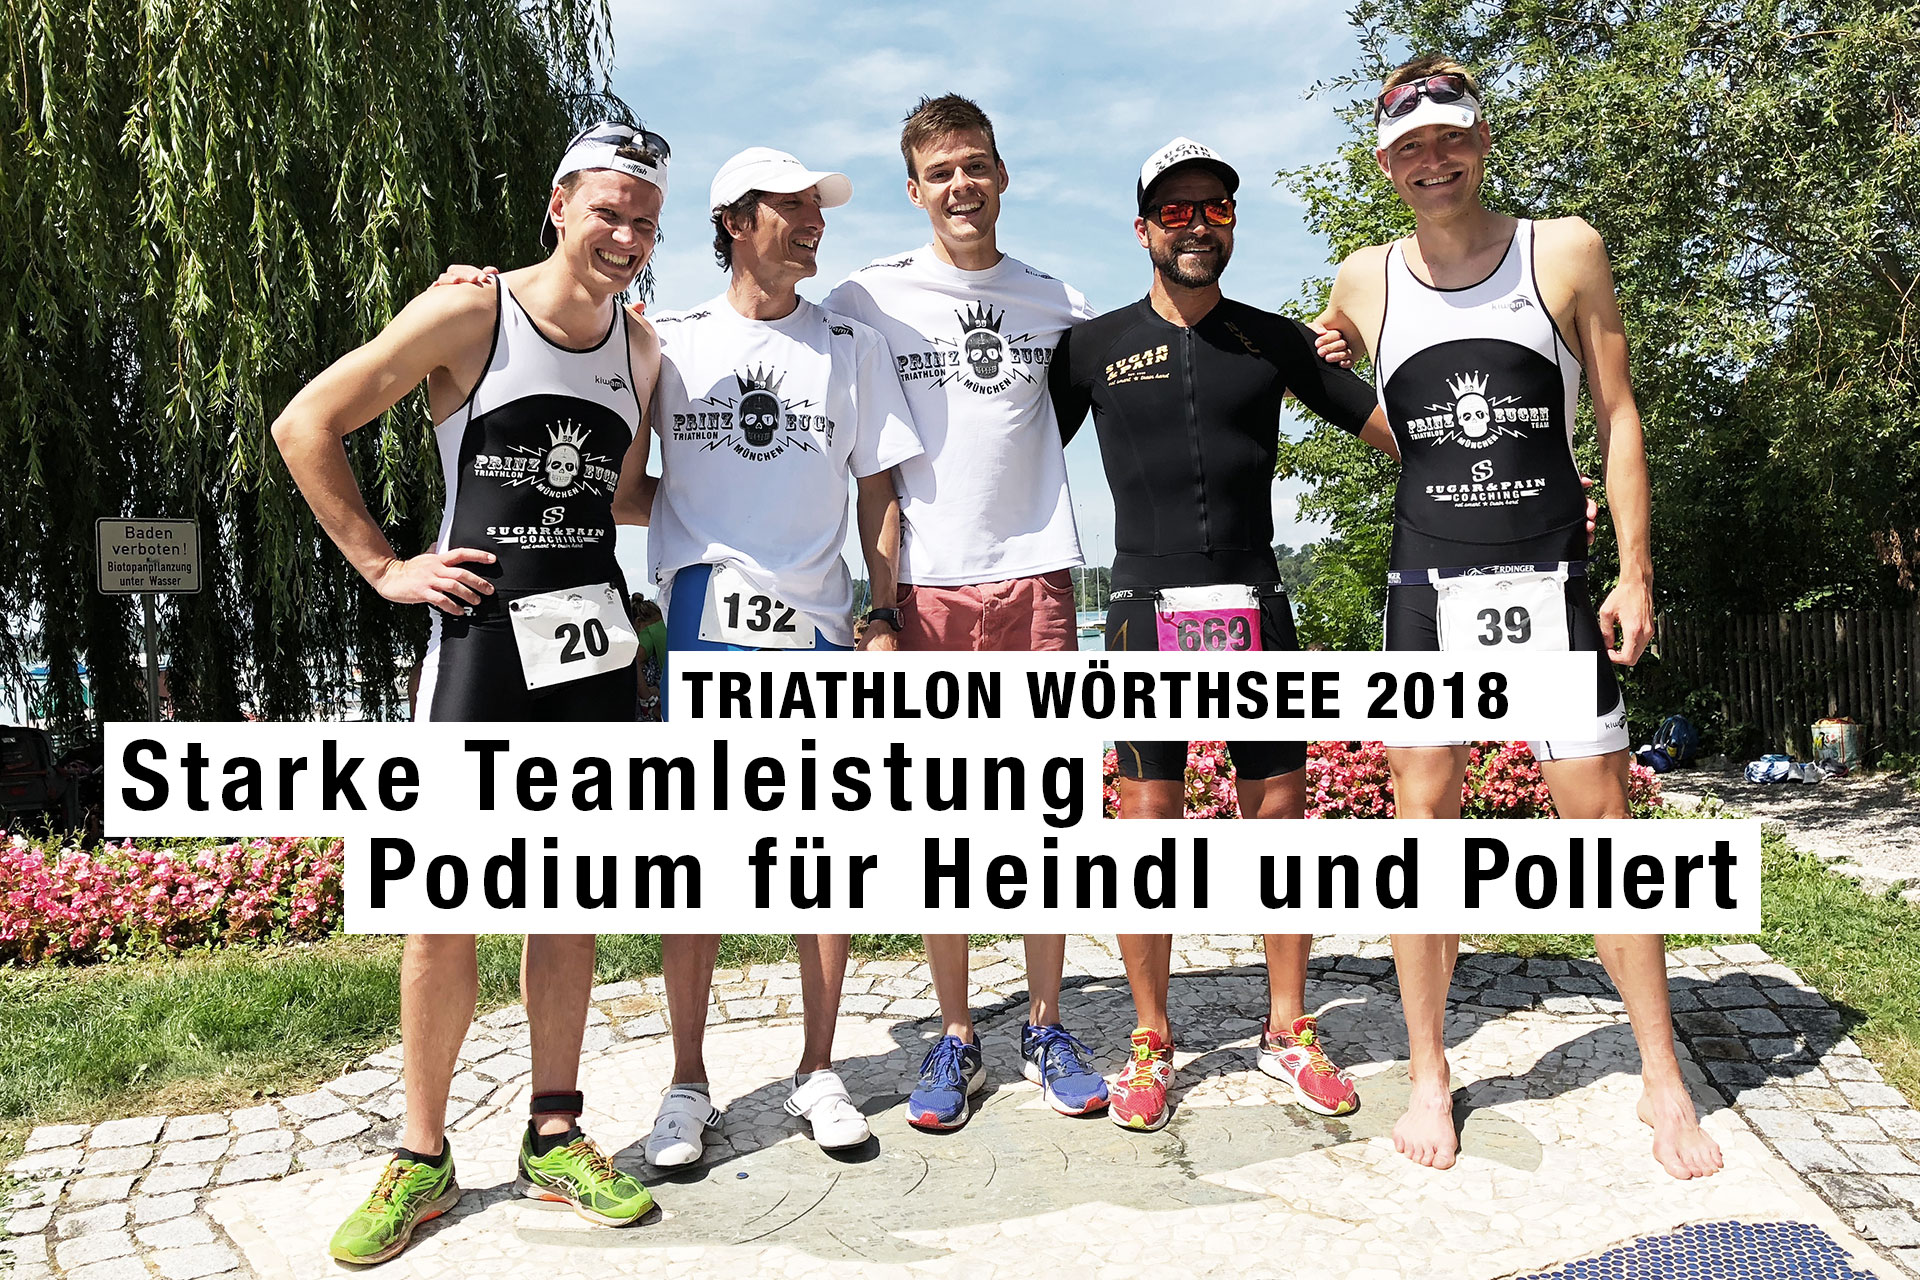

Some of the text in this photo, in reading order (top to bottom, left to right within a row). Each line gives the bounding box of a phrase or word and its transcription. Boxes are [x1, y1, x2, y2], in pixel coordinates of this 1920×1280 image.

[896, 351, 960, 373] PRINZ
[1105, 344, 1169, 374] SUGAR
[900, 369, 946, 382] TRIATHLON
[964, 377, 1012, 395] MÜNCHEN
[672, 412, 733, 431] PRINZ
[1407, 407, 1550, 434] PRINZ EUGEN
[673, 432, 718, 440] TRIATHLON
[1410, 421, 1550, 440] TRIATHLON TEAM
[1457, 434, 1499, 449] MÜNCHEN
[733, 443, 784, 462] MÜNCHEN
[474, 454, 541, 472] PRINZ
[474, 469, 523, 479] TRIATHLON
[536, 483, 579, 498] MÜNCHEN
[1453, 490, 1520, 502] COACHING
[125, 526, 173, 539] Baden
[520, 535, 584, 544] COACHING
[107, 561, 192, 574] Biotopanpflanzung
[119, 576, 181, 586] unter Wasser
[723, 592, 797, 633] 132
[1177, 616, 1252, 651] 669
[1476, 606, 1532, 646] 39
[554, 618, 609, 664] 20
